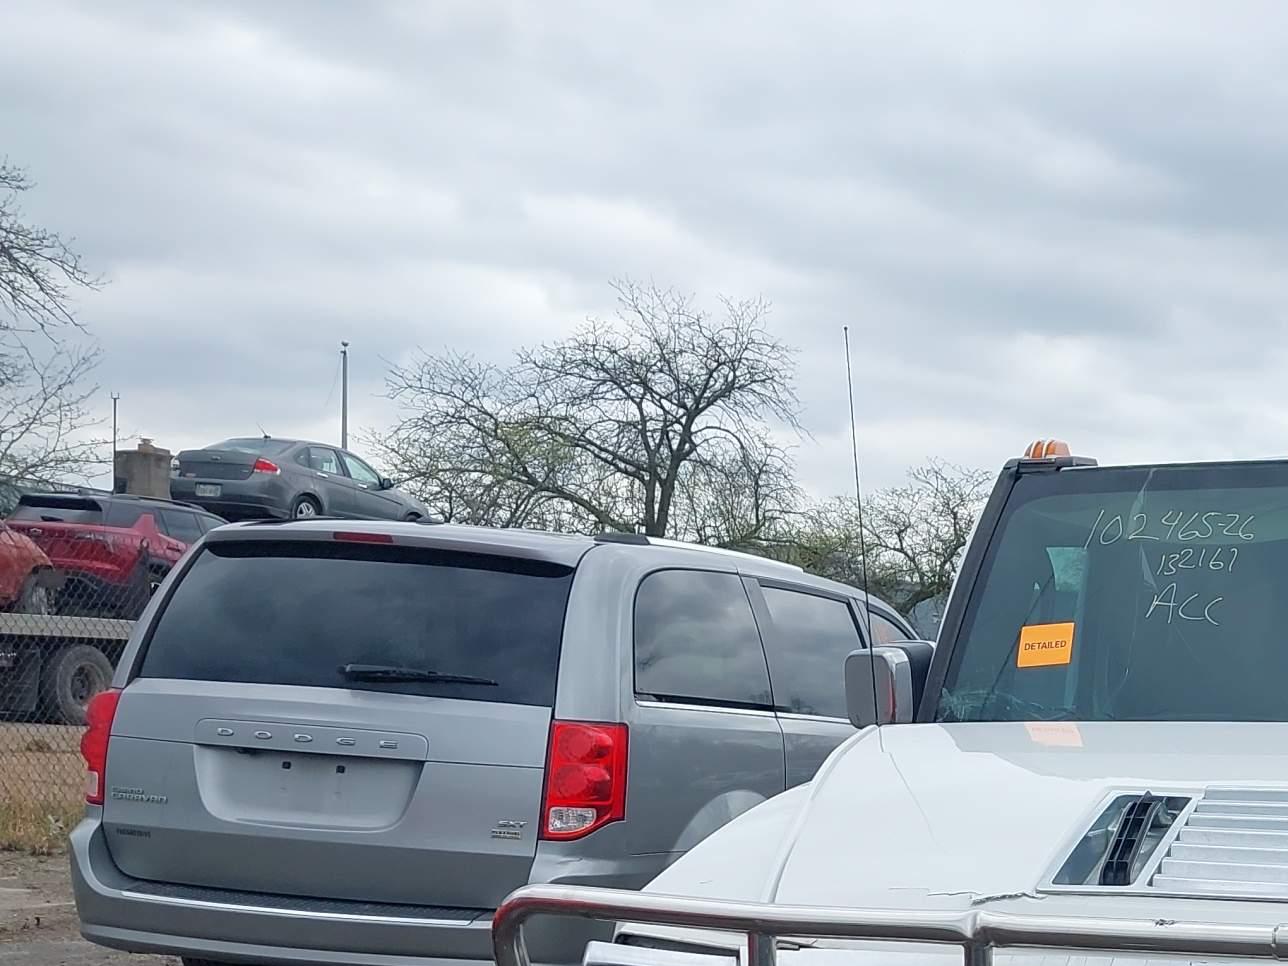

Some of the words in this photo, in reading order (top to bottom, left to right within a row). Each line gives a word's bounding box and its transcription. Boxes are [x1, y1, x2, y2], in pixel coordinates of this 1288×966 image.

[1156, 547, 1238, 575] 132167
[1145, 583, 1223, 626] ACC
[1023, 639, 1067, 652] DETAILED
[216, 727, 399, 749] DODGE
[111, 791, 169, 804] CARAVAN
[497, 820, 529, 828] SXT
